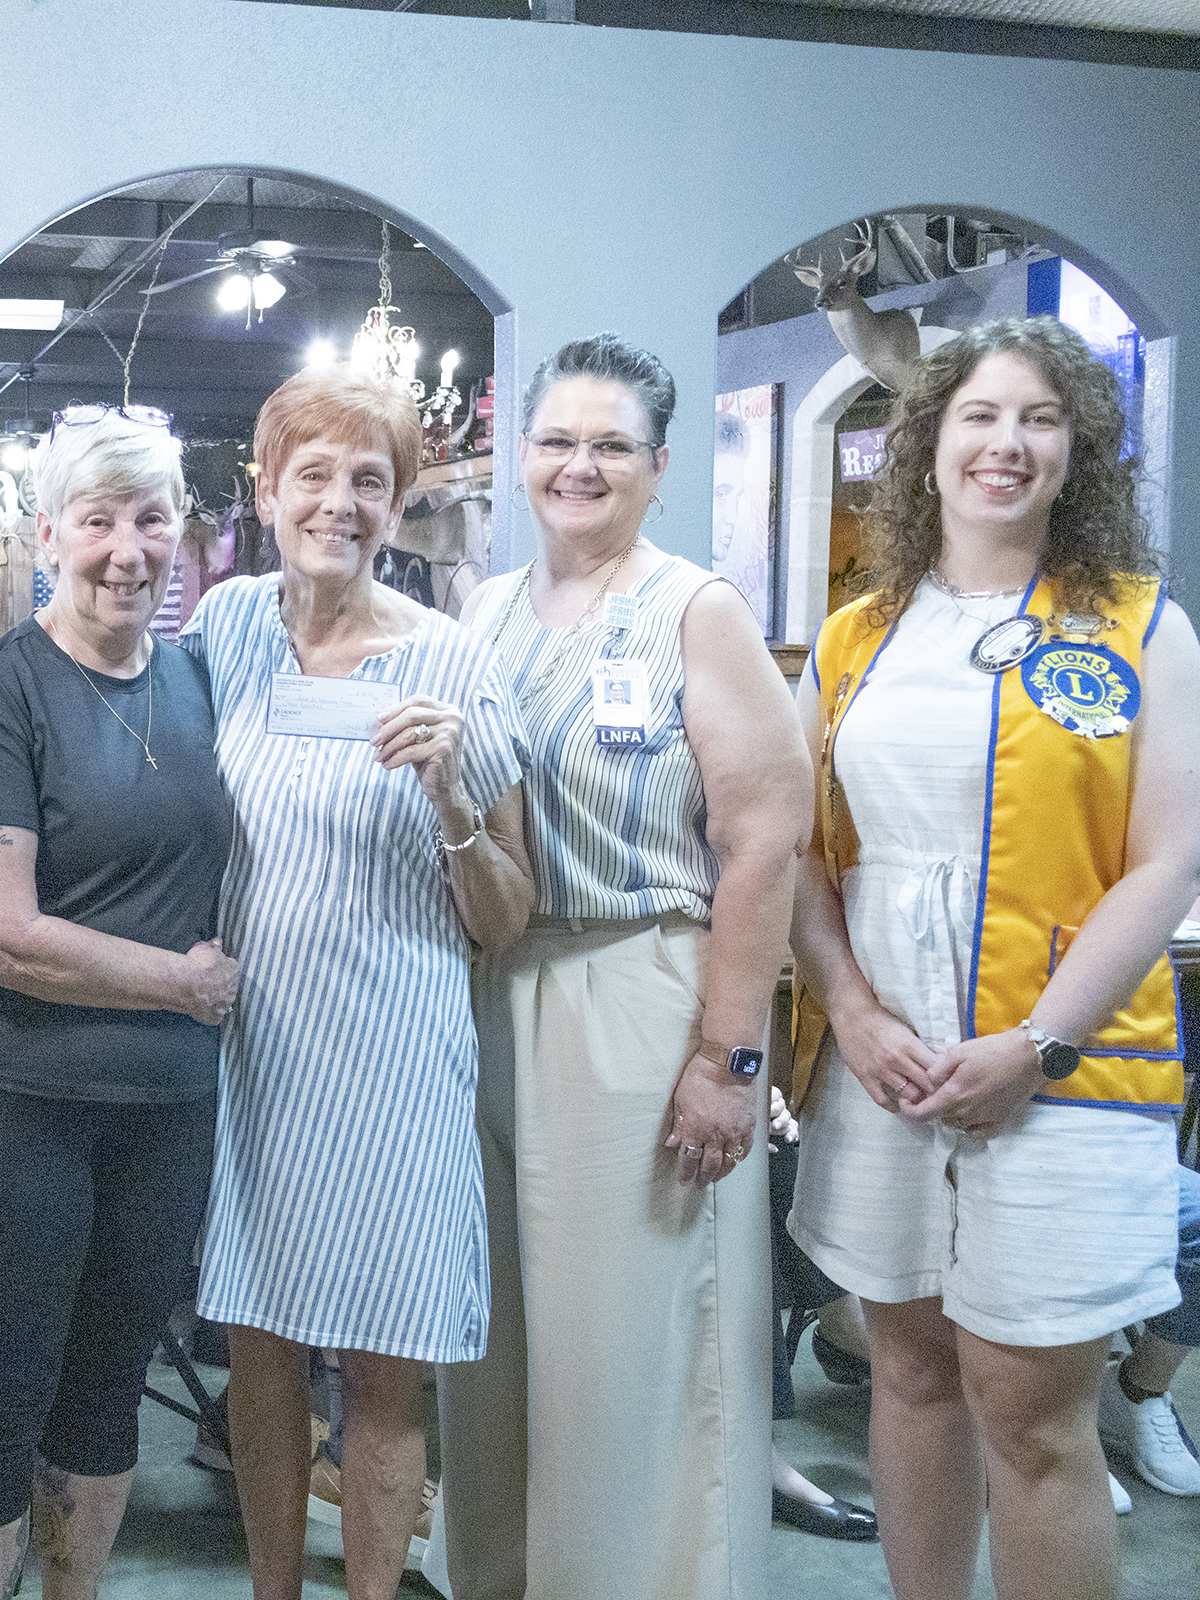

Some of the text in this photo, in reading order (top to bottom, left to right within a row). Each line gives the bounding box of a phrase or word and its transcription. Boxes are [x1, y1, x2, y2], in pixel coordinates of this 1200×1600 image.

[608, 594, 637, 608] JESUS
[606, 604, 636, 618] JESUS
[605, 614, 634, 628] JESUS
[1047, 652, 1106, 673] LIONS
[1066, 672, 1095, 701] L
[600, 730, 642, 743] LNFA
